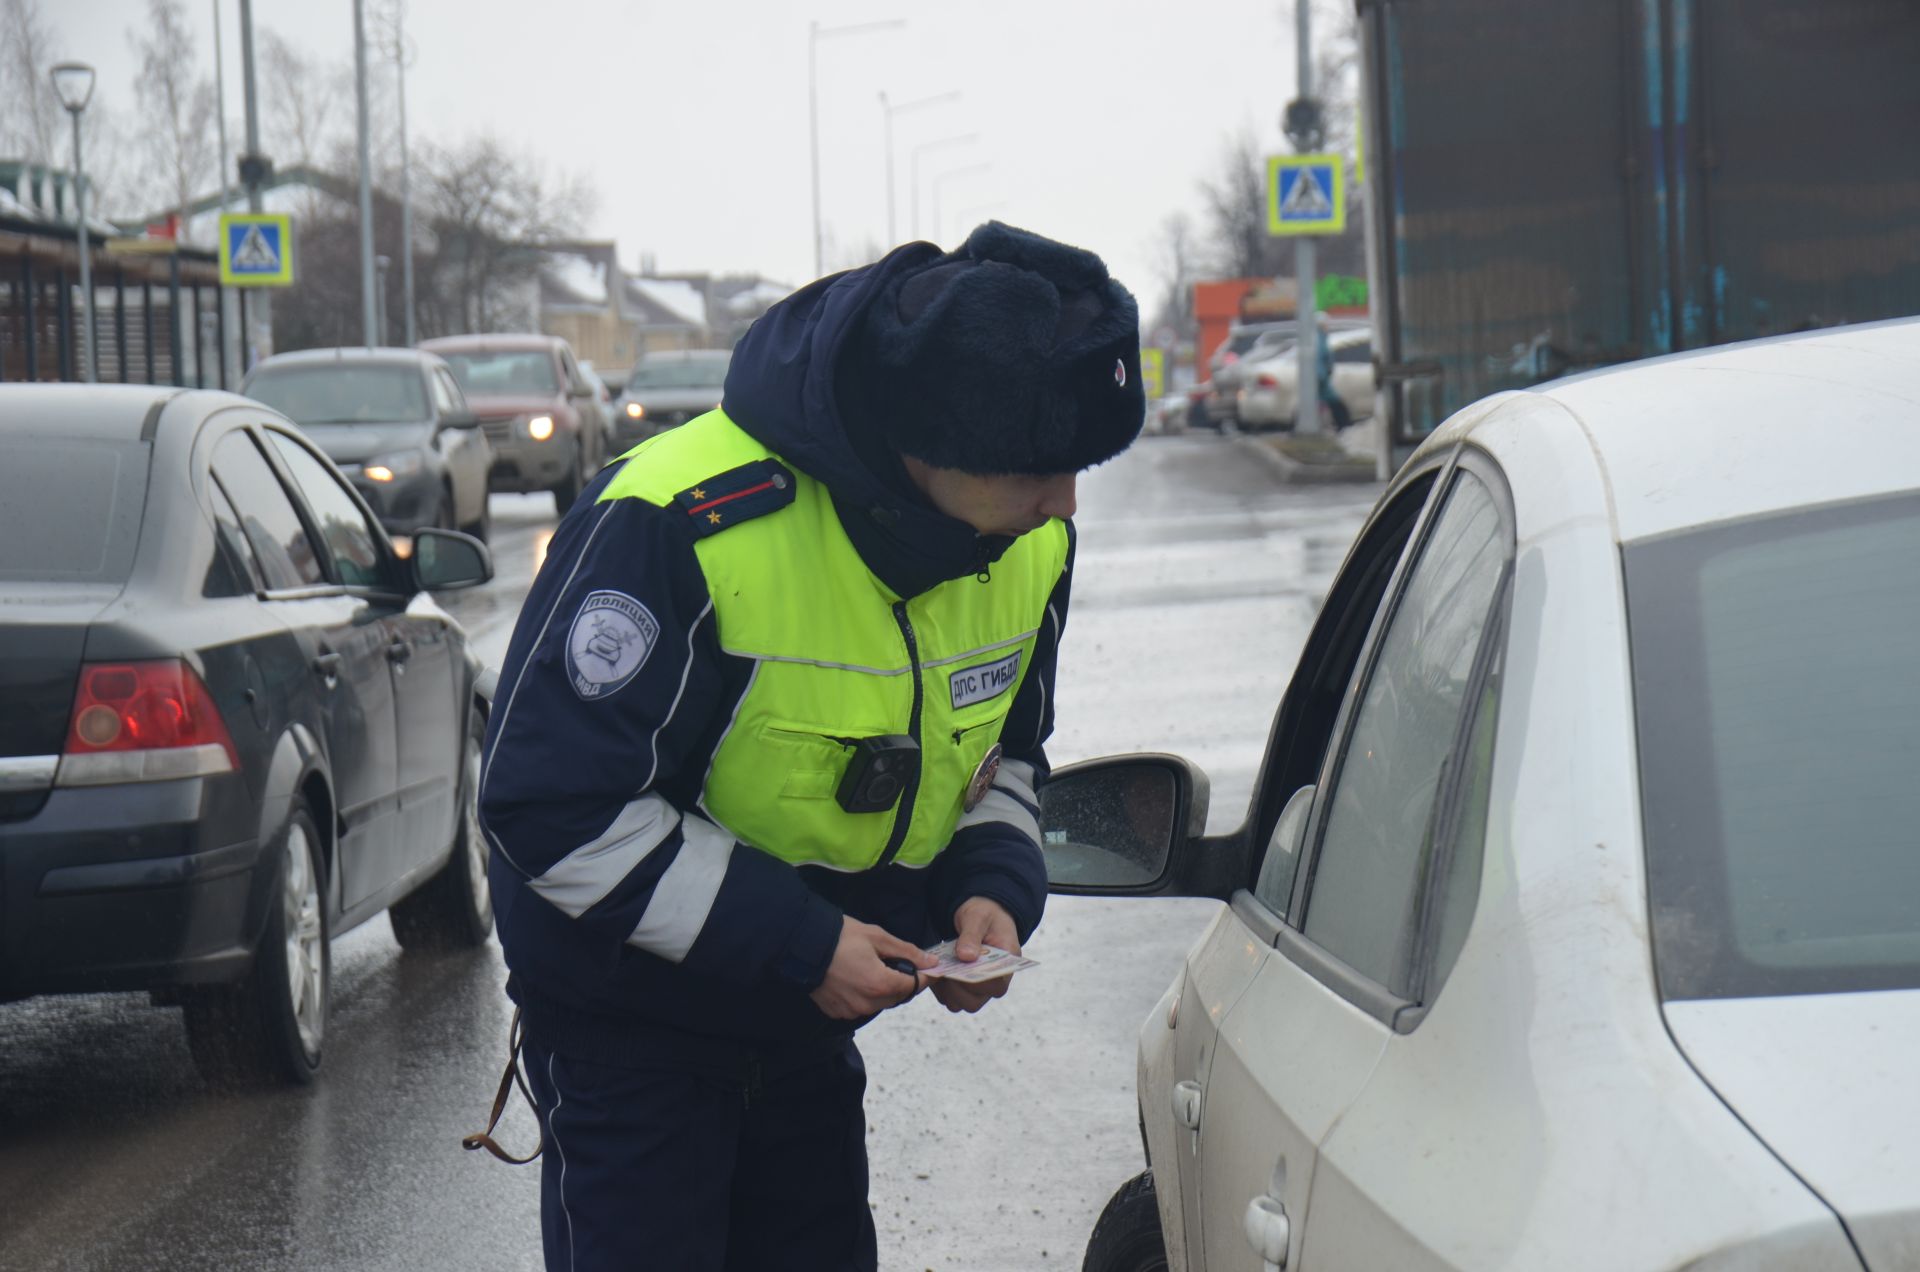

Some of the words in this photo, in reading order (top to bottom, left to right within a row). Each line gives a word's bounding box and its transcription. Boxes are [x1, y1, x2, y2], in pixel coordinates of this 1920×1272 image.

[589, 597, 653, 636] ПОЛИЦИЯ
[575, 674, 601, 696] МВД
[954, 676, 977, 700] ДПС
[981, 658, 1018, 690] ГИБДД
